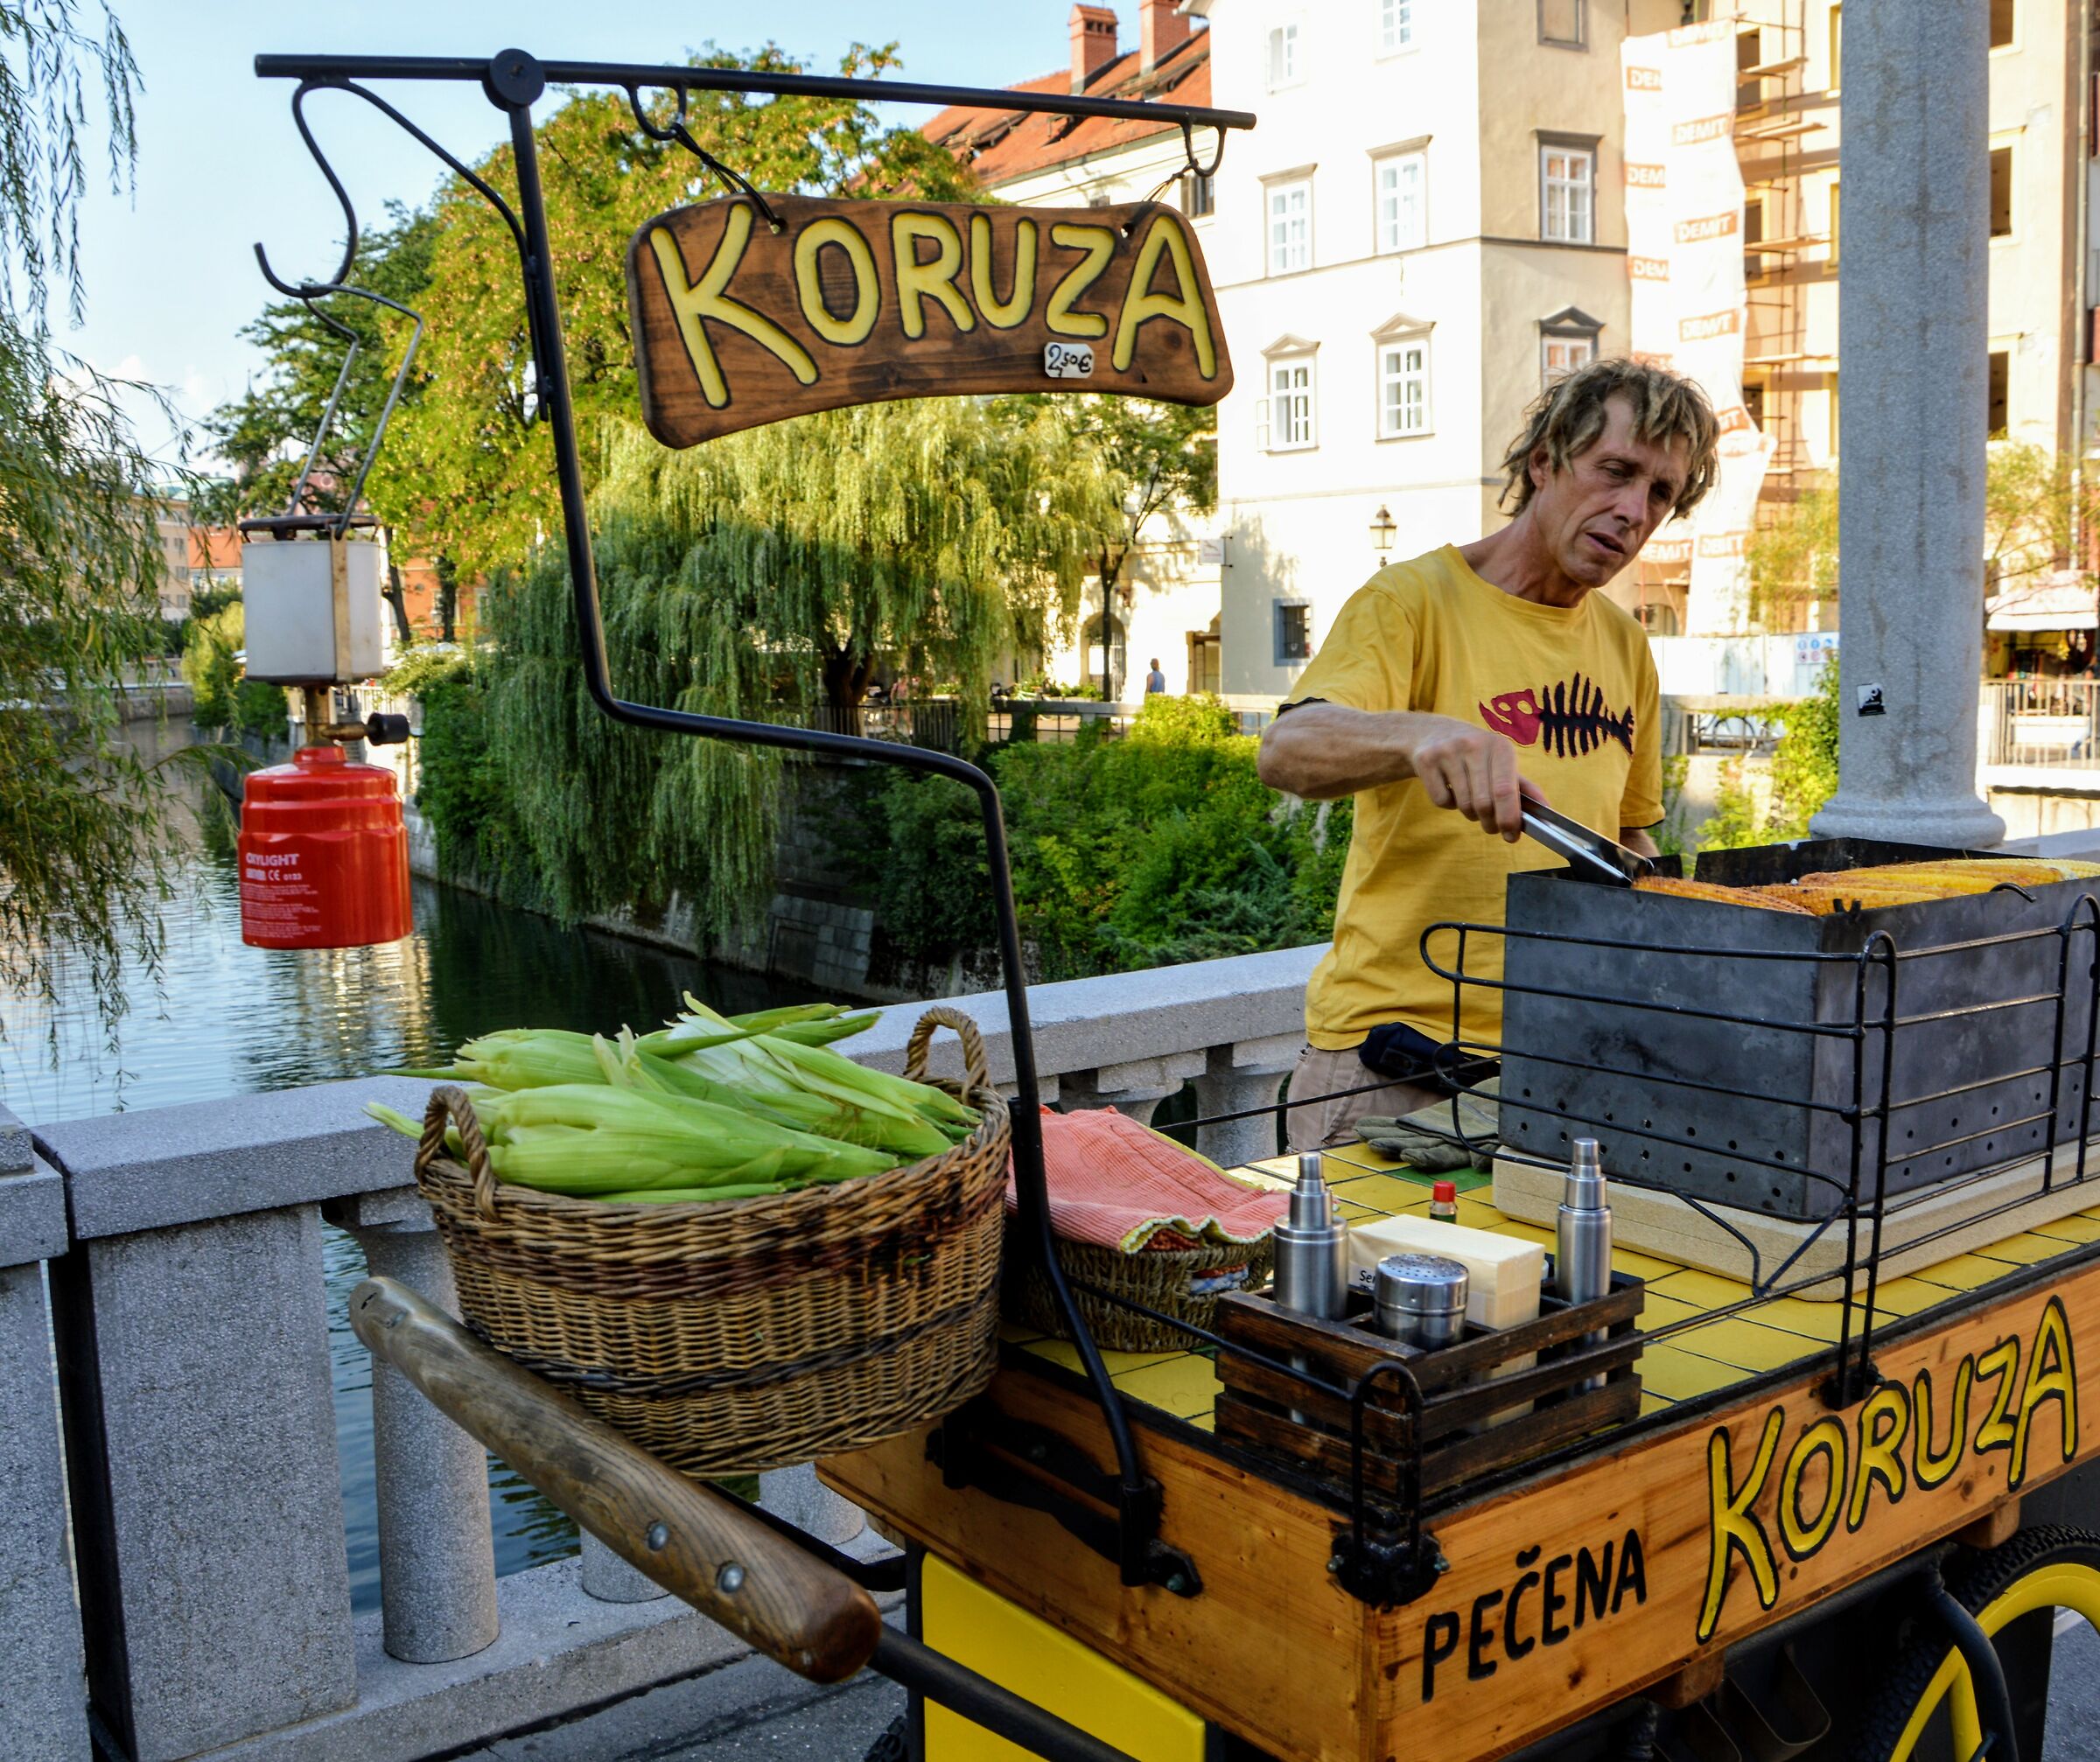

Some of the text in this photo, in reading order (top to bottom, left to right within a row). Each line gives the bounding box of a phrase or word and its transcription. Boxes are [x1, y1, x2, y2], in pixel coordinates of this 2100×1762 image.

[1676, 116, 1727, 142] DEMIT
[1678, 215, 1732, 241] DEMIT
[648, 201, 1219, 410] KORUZA
[1681, 312, 1733, 340] DEMIT
[1420, 1295, 2079, 1704] PEČENA KORUZA
